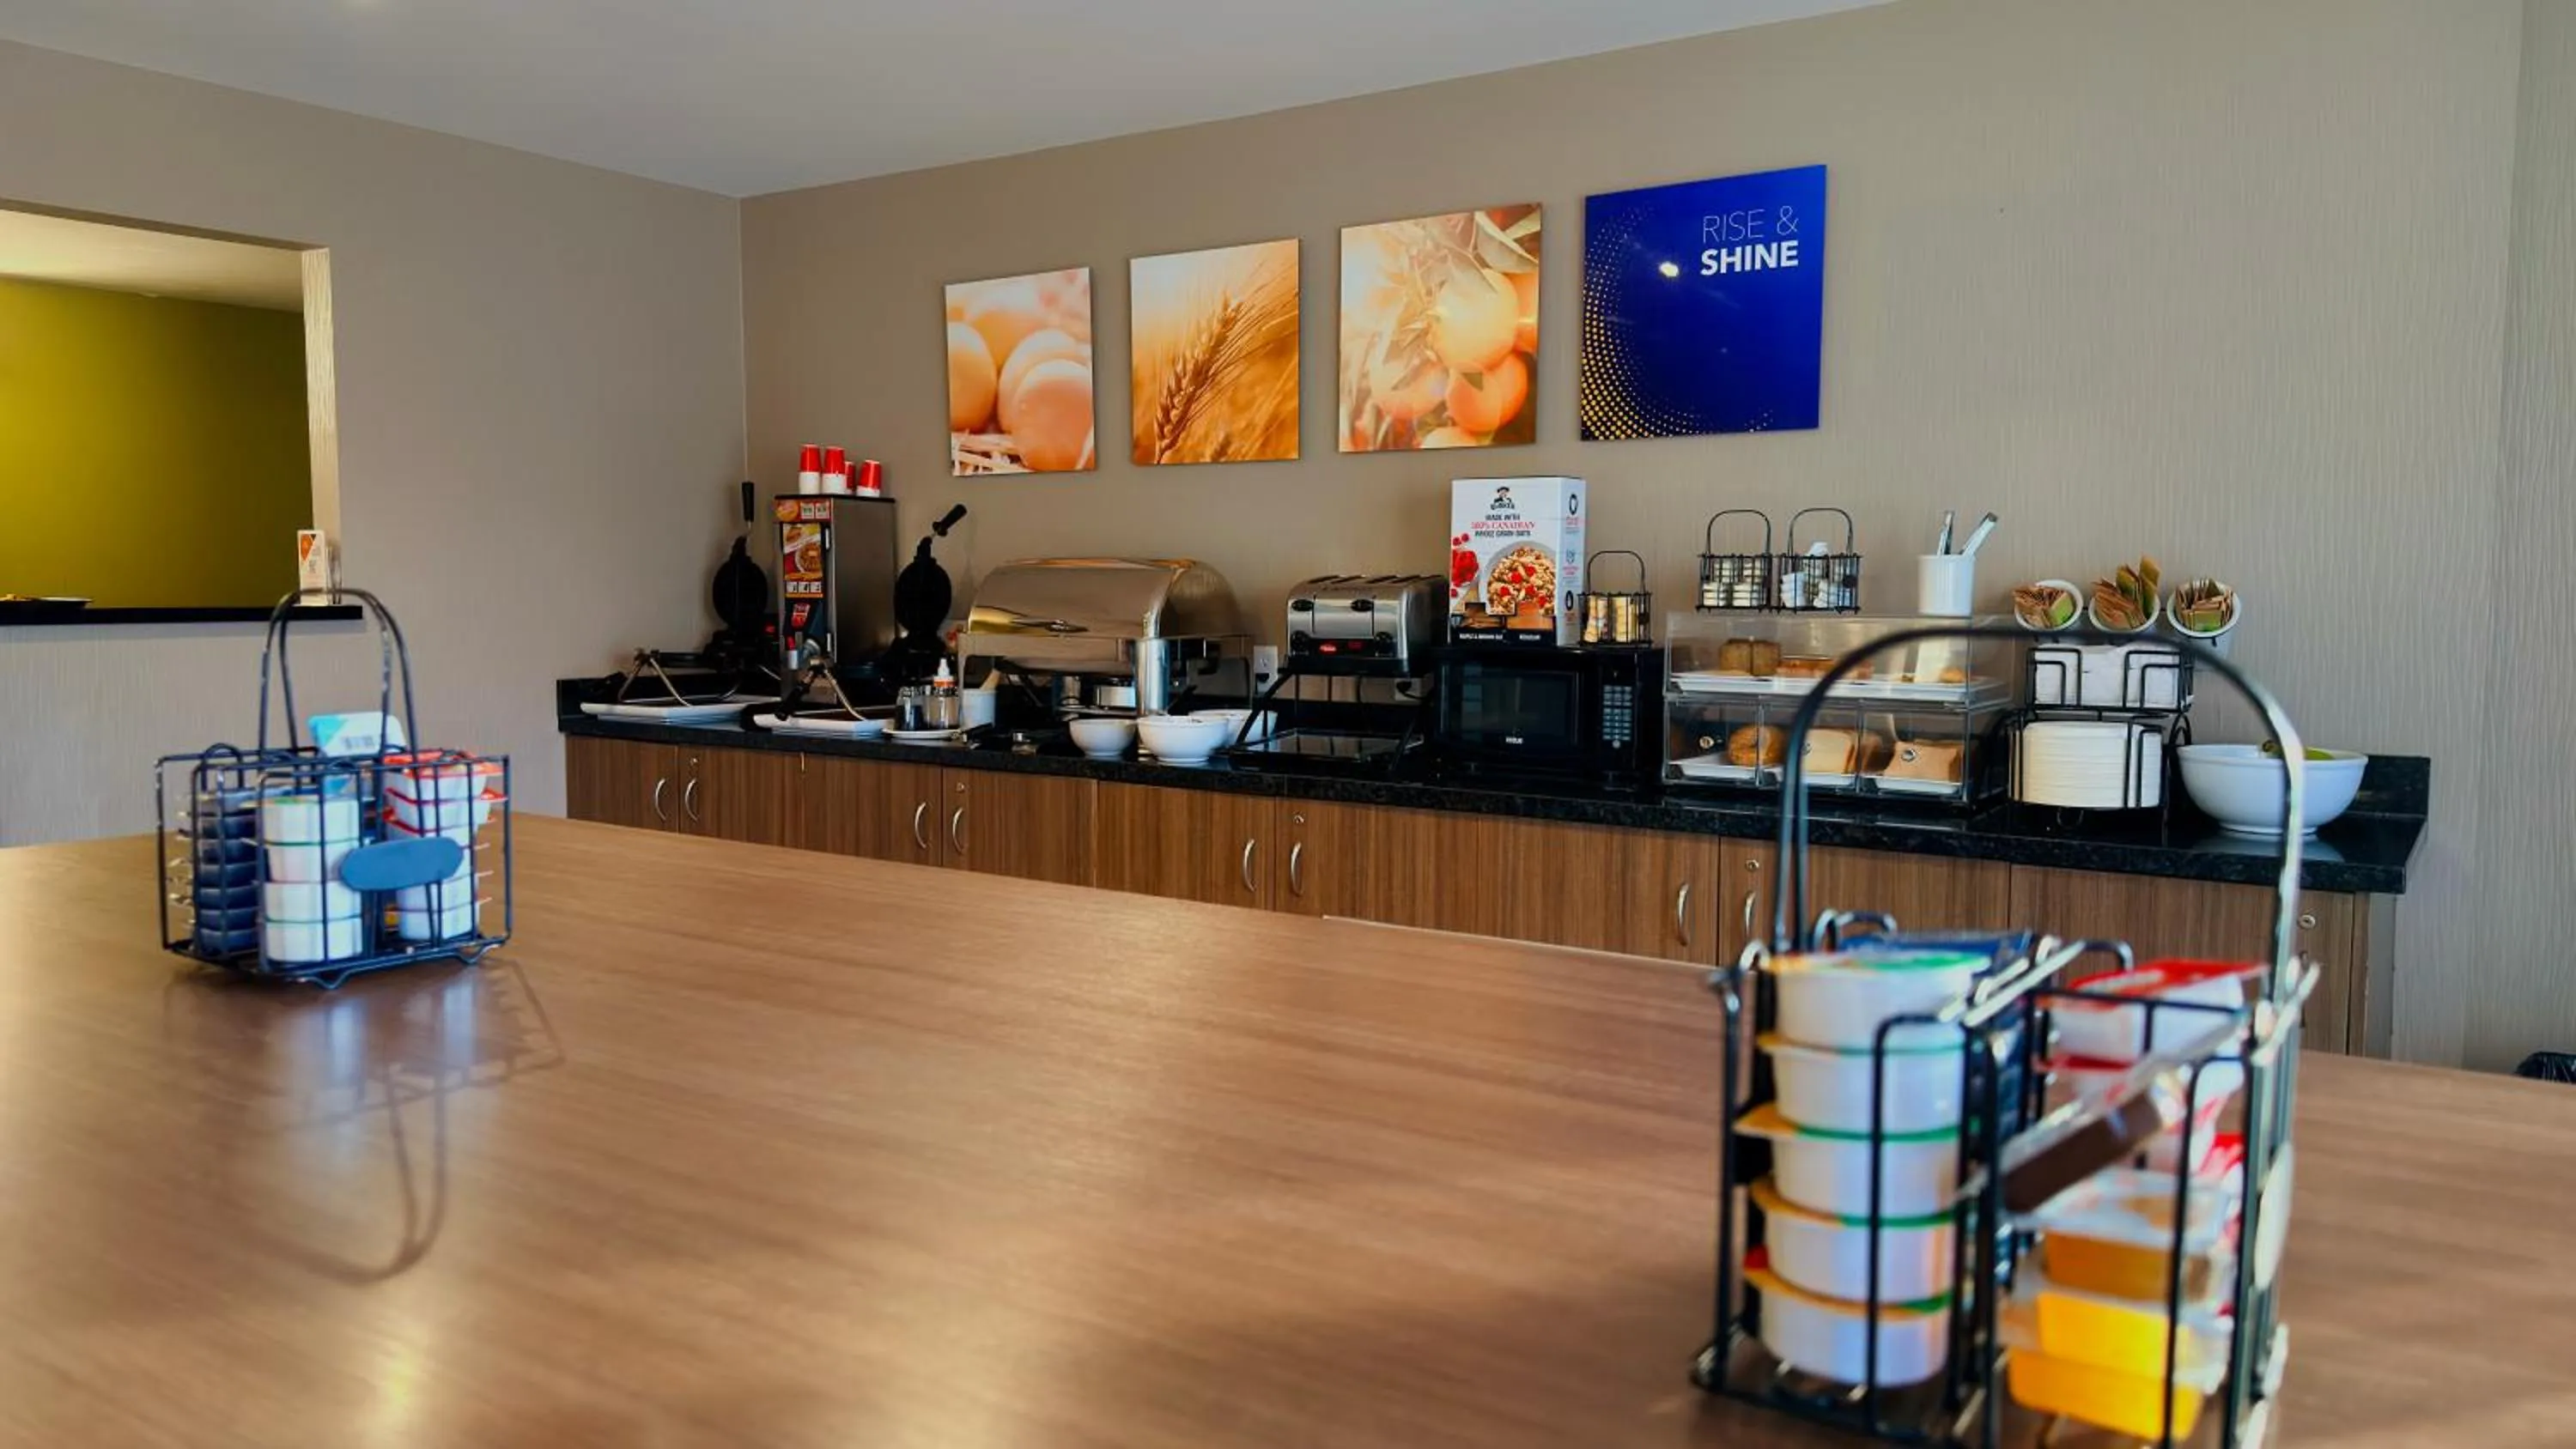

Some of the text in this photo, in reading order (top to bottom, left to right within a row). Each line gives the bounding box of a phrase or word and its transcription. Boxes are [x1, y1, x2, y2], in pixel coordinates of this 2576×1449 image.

[1703, 205, 1800, 244] RISE &
[1700, 239, 1799, 276] SHINE
[1492, 521, 1536, 530] CANADIAN
